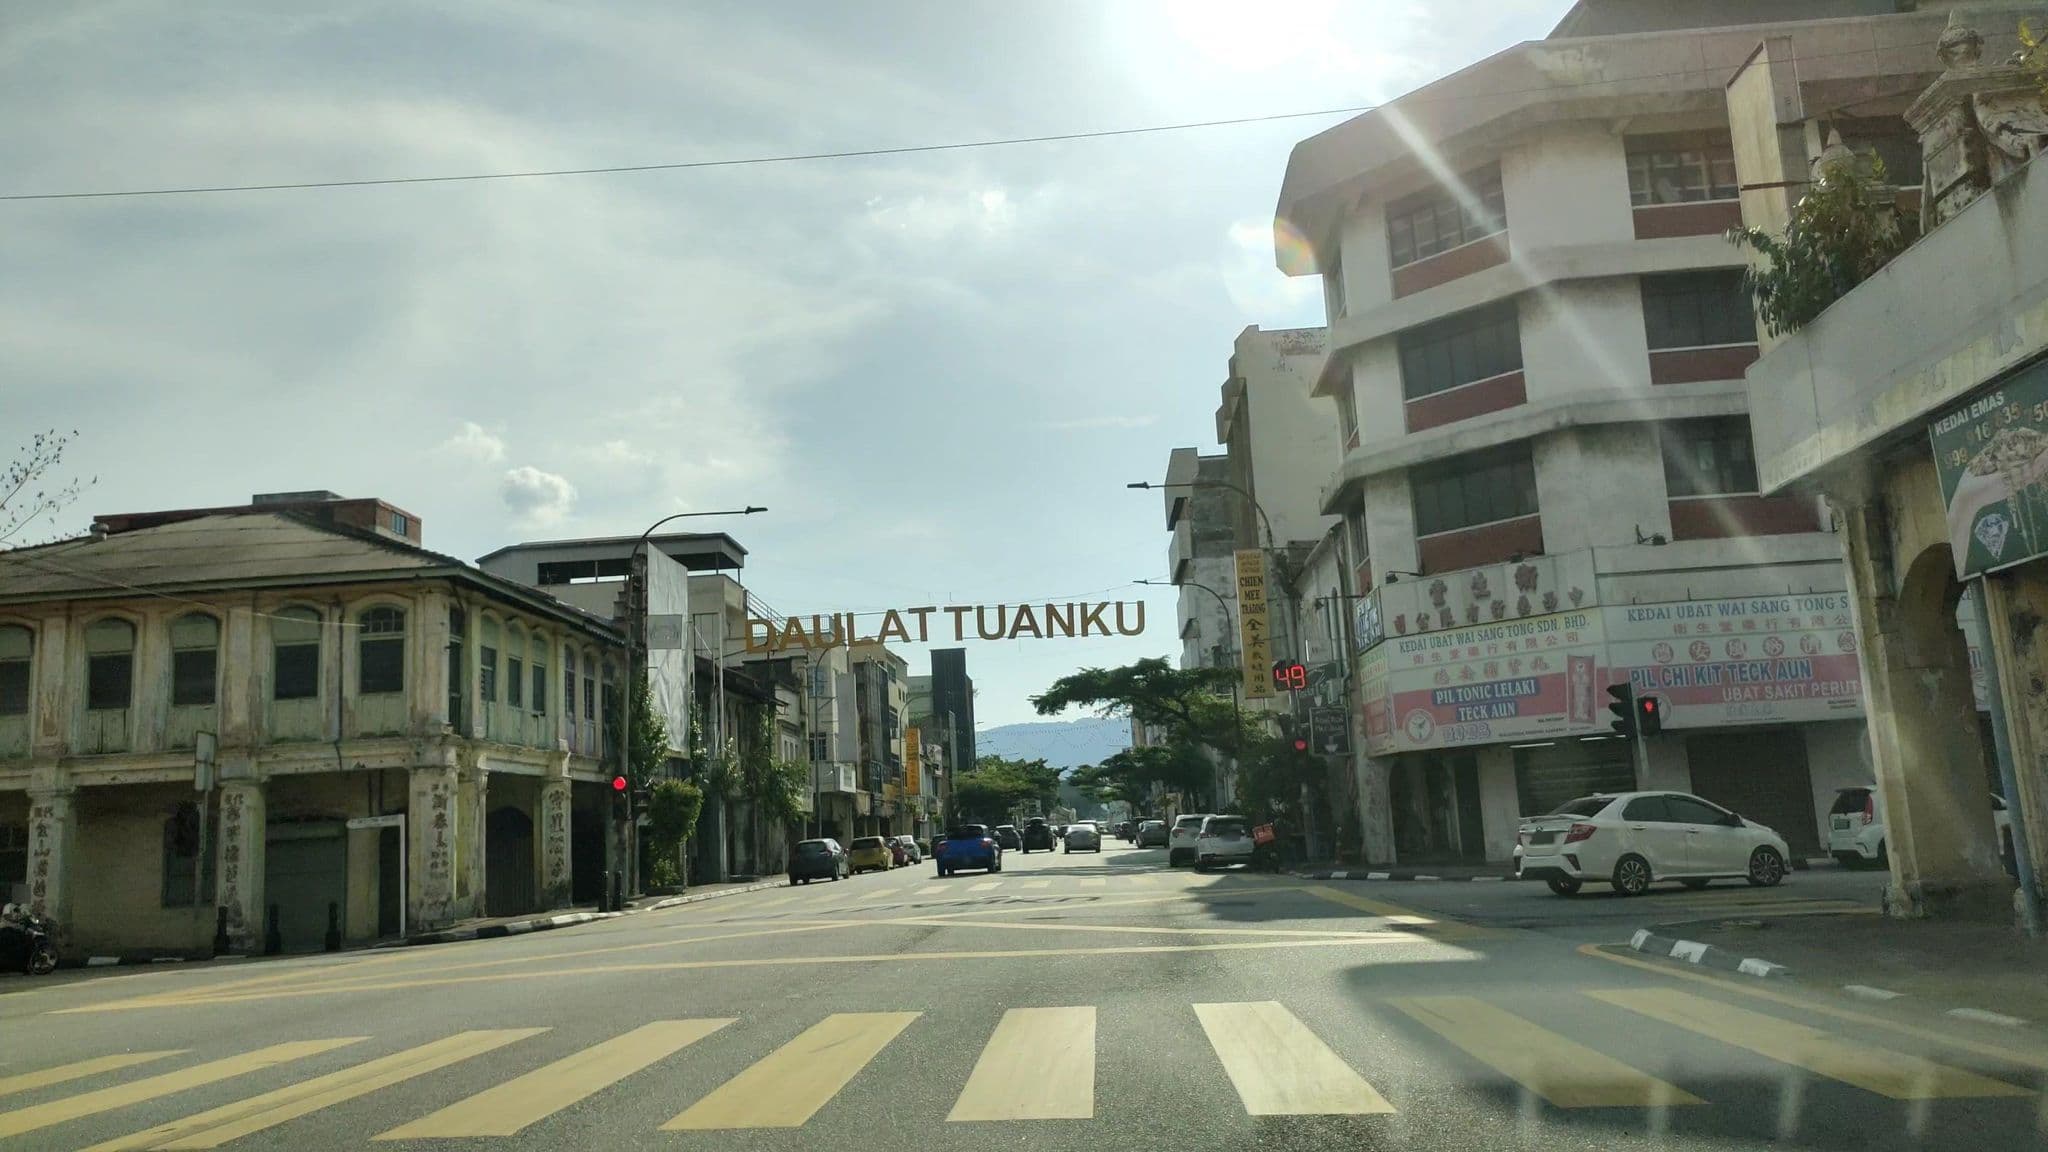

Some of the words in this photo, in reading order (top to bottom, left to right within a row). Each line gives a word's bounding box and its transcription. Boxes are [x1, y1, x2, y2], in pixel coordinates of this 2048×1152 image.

[1934, 408, 1968, 436] KEDAI
[1970, 391, 2004, 418] EMAS
[1240, 576, 1264, 588] CHIEN
[1244, 589, 1260, 600] MEE
[1241, 602, 1266, 615] TRADING
[1628, 608, 1671, 622] KEDAI
[1677, 604, 1712, 618] UBAT
[1718, 602, 1745, 616] WAI
[1752, 598, 1790, 614] SANG
[1796, 596, 1835, 611] TONG
[745, 606, 937, 653] DAULAT
[944, 600, 1146, 641] TUANKU
[1399, 636, 1427, 654] KEDAI
[1429, 633, 1454, 649] UBAT
[1455, 630, 1475, 645] WAI
[1478, 626, 1504, 642] SANG
[1505, 622, 1534, 638] TONG
[1537, 618, 1561, 633] SDN.
[1565, 614, 1590, 629] BHD.
[1275, 664, 1306, 689] 49
[1630, 670, 1657, 689] PIL
[1661, 667, 1689, 687] CHI
[1695, 664, 1723, 684] KIT
[1727, 661, 1771, 682] TECK
[1776, 659, 1812, 679] AUN
[1436, 687, 1454, 704] PIL
[1456, 683, 1492, 701] TONIC
[1494, 679, 1536, 698] LELAKI
[1722, 685, 1758, 702] UBAT
[1764, 683, 1806, 699] SAKIT
[1811, 680, 1859, 697] PERUT
[1458, 704, 1488, 722] TECK
[1491, 701, 1516, 718] AUN
